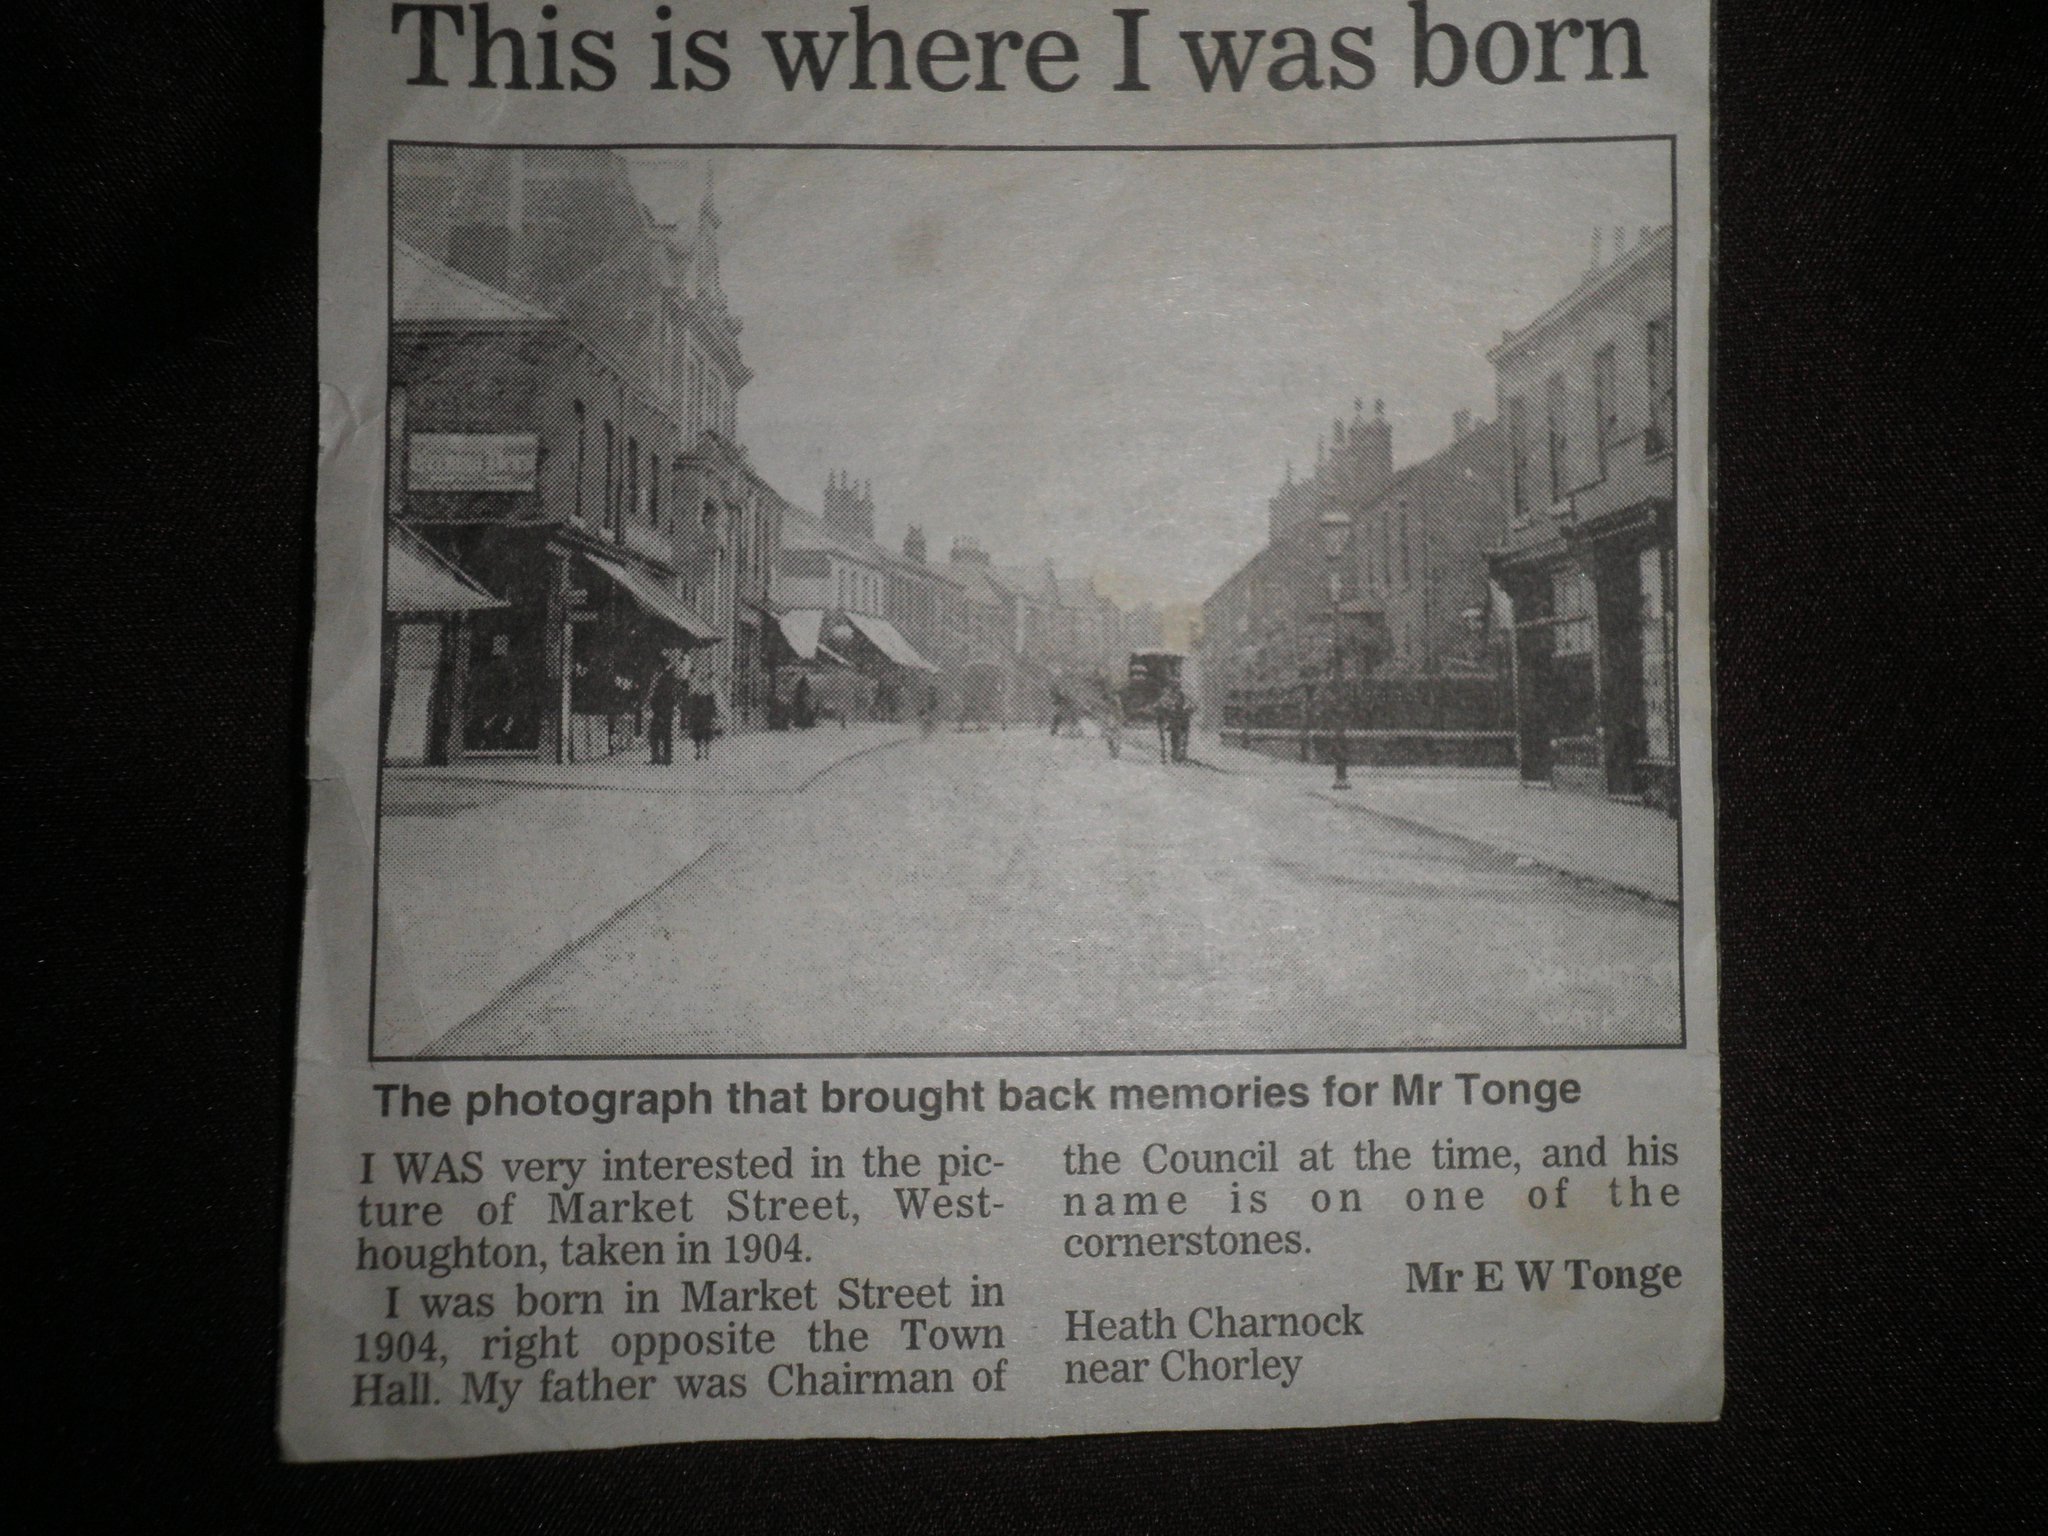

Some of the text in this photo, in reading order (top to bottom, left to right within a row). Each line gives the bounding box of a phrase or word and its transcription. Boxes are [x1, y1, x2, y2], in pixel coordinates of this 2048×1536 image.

[391, 0, 1649, 93] This is where I was born
[373, 1073, 1581, 1125] The photograph that brought back memories for Mr Tonge
[360, 1145, 1004, 1190] I WAS very interested in the pic-
[1063, 1134, 1679, 1175] the Council at the time, and his
[358, 1187, 1004, 1228] ture of Market Street, West-
[1063, 1175, 1680, 1216] name is on one of the
[356, 1232, 811, 1278] houghton, taken in 1904.
[1064, 1225, 1311, 1258] cornerstones.
[386, 1274, 1005, 1319] I was born in Market Street in
[1406, 1259, 1682, 1298] Mr E W Tonge
[356, 1319, 1005, 1368] 1904, right opposite the Town
[1065, 1303, 1364, 1341] Heath Charnock
[351, 1358, 1008, 1413] Hall. My father was Chairman of
[1065, 1347, 1303, 1389] near Chorley
